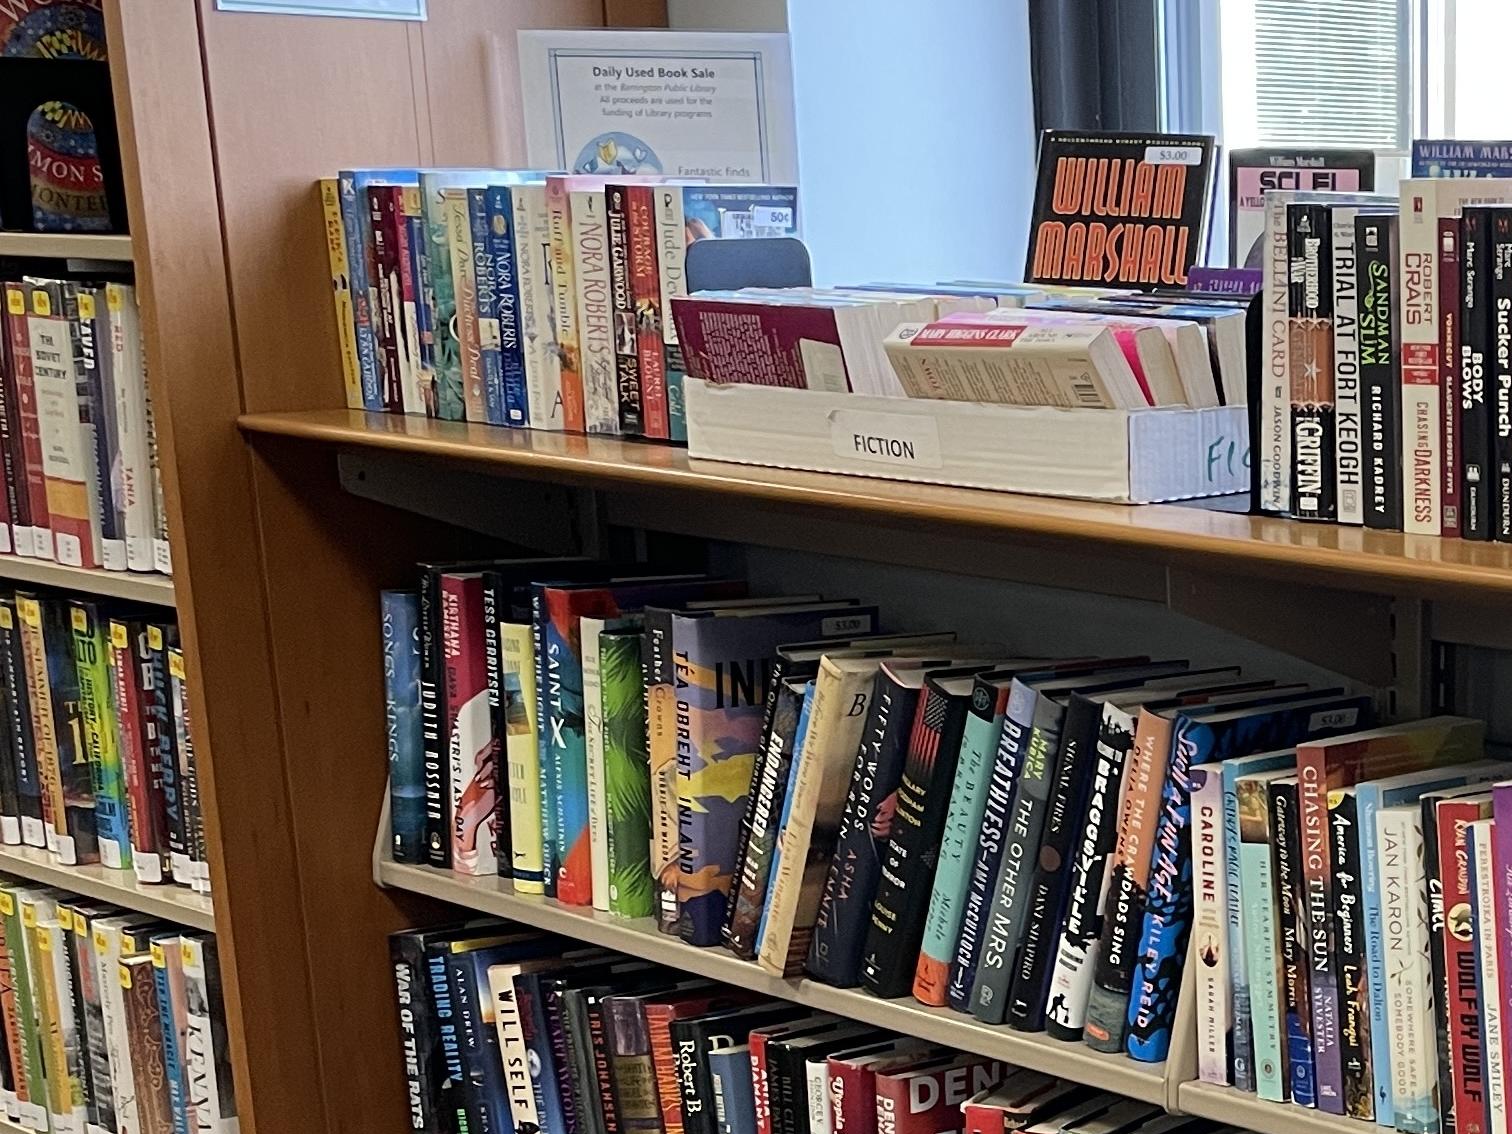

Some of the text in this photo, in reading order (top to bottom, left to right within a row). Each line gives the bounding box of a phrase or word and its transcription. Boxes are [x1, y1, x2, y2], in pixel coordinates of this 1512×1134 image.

[593, 67, 715, 79] Daily Used Book Sale
[678, 166, 750, 176] Fantastic finds
[1053, 157, 1186, 219] WILLIAM
[1159, 150, 1188, 162] $3.00
[1419, 145, 1473, 162] WILLIAM
[771, 212, 789, 223] 50¢
[577, 220, 608, 353] NORA ROBERTS
[1033, 222, 1189, 284] MARSHALL
[1334, 242, 1359, 485] TRIAL AT FORT KEOGH
[1497, 298, 1511, 369] Sucker
[854, 433, 915, 460] FICTION
[547, 642, 562, 712] SAINT
[984, 798, 1033, 970] THE OTHER MRS.
[1200, 805, 1215, 903] CAROLINE
[1302, 764, 1328, 972] CHASING THE SUN
[1383, 826, 1403, 952] JAN KARON
[497, 990, 529, 1111] WILL SELF
